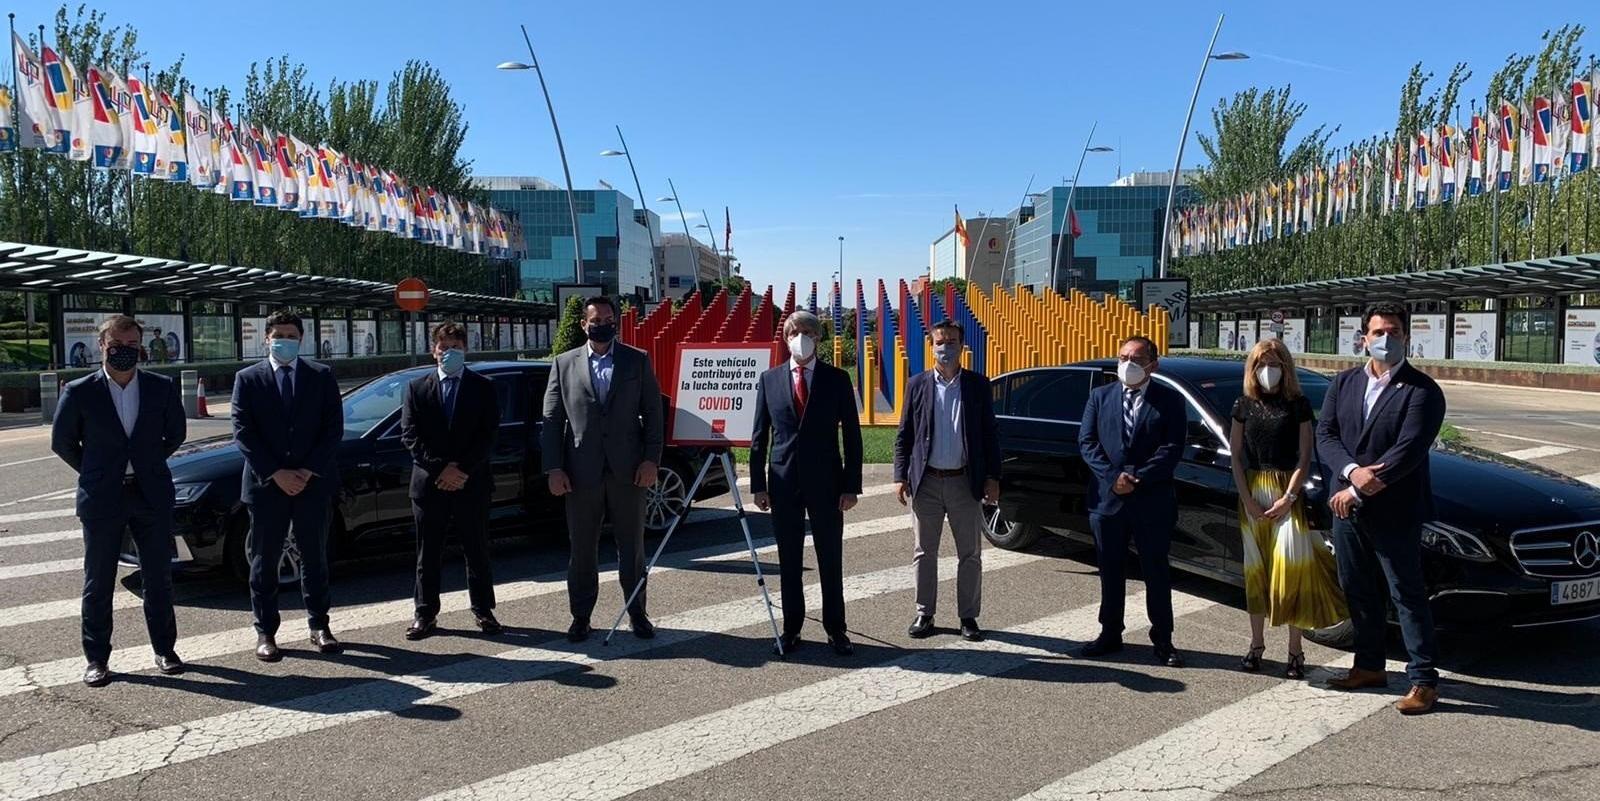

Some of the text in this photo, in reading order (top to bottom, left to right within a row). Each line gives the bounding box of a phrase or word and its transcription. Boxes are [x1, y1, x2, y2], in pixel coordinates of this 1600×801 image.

[693, 356, 757, 367] Este vehículo
[691, 368, 756, 380] contribuyó en
[681, 381, 690, 391] la
[692, 381, 719, 391] lucha
[721, 382, 752, 391] contra
[698, 396, 743, 411] COVID19
[1562, 580, 1594, 600] 4887
